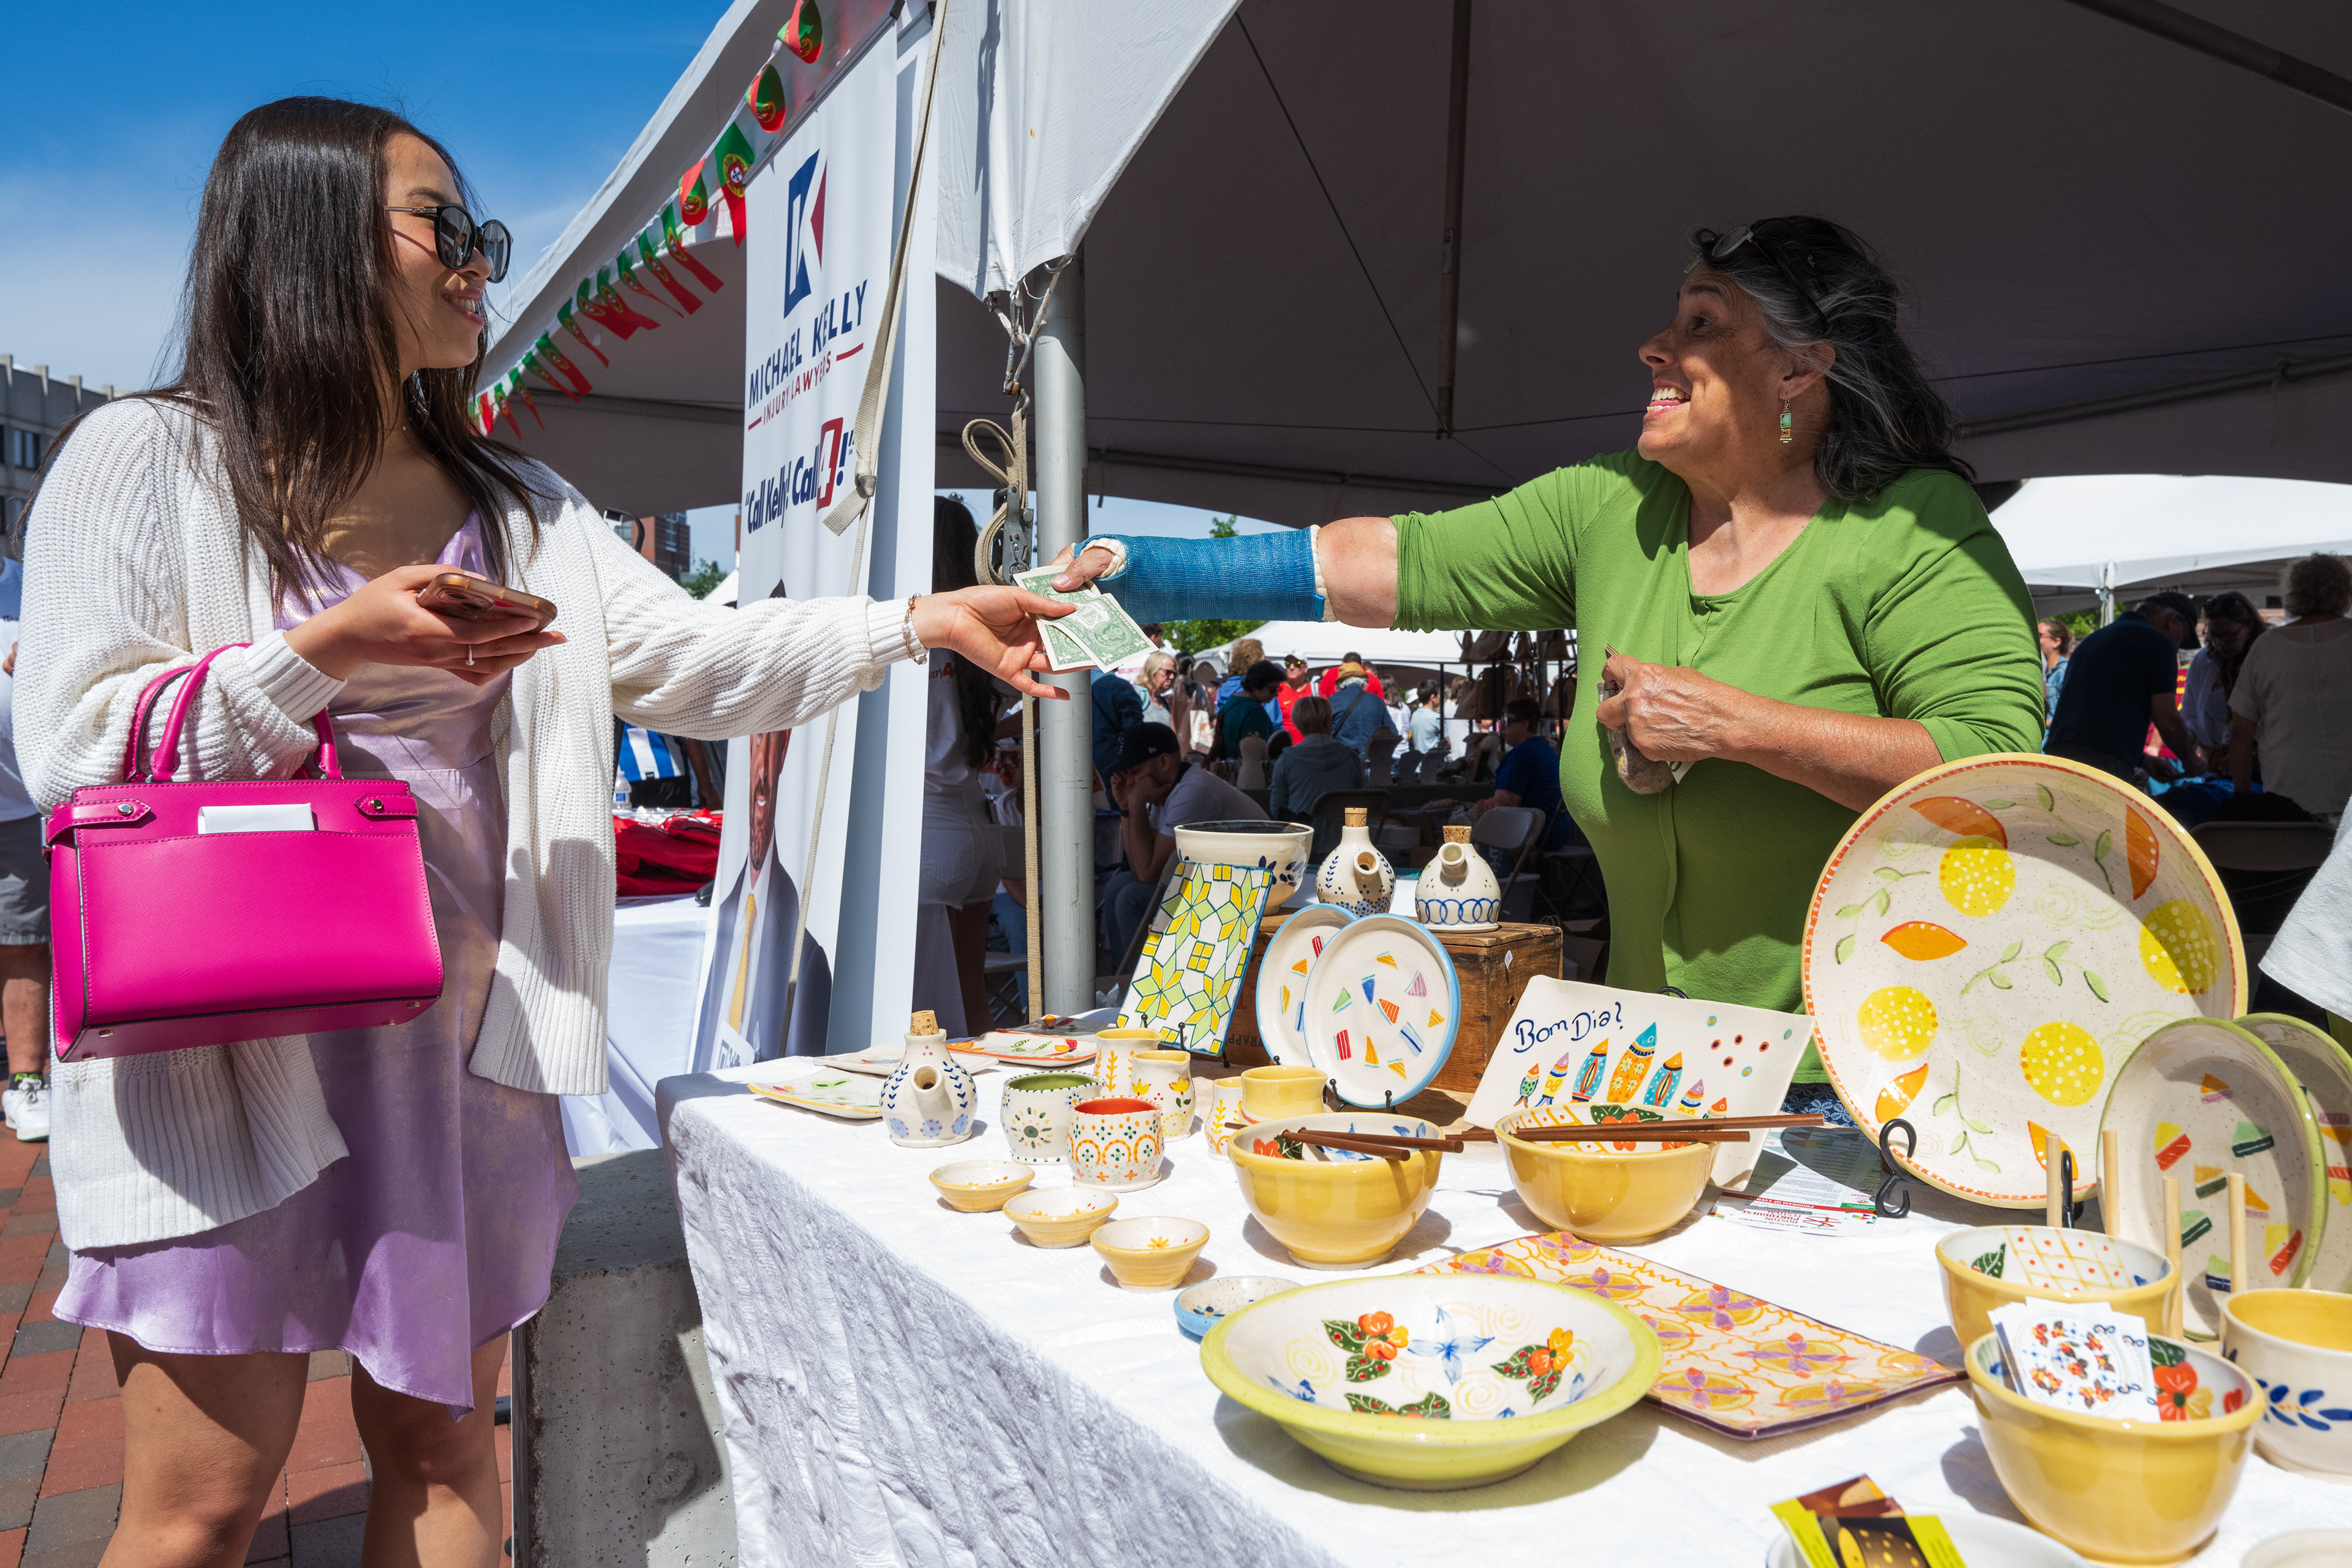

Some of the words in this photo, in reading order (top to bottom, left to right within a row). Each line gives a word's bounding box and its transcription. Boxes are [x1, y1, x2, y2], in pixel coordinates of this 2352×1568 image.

[748, 327, 802, 409] MICHAEL
[812, 278, 868, 358] KELLY
[763, 379, 790, 426] INJURY
[791, 350, 832, 402] LAWYERS
[792, 443, 820, 507] Call
[1513, 1019, 1569, 1053] Bom
[1742, 1210, 1800, 1220] PORTUGUESE
